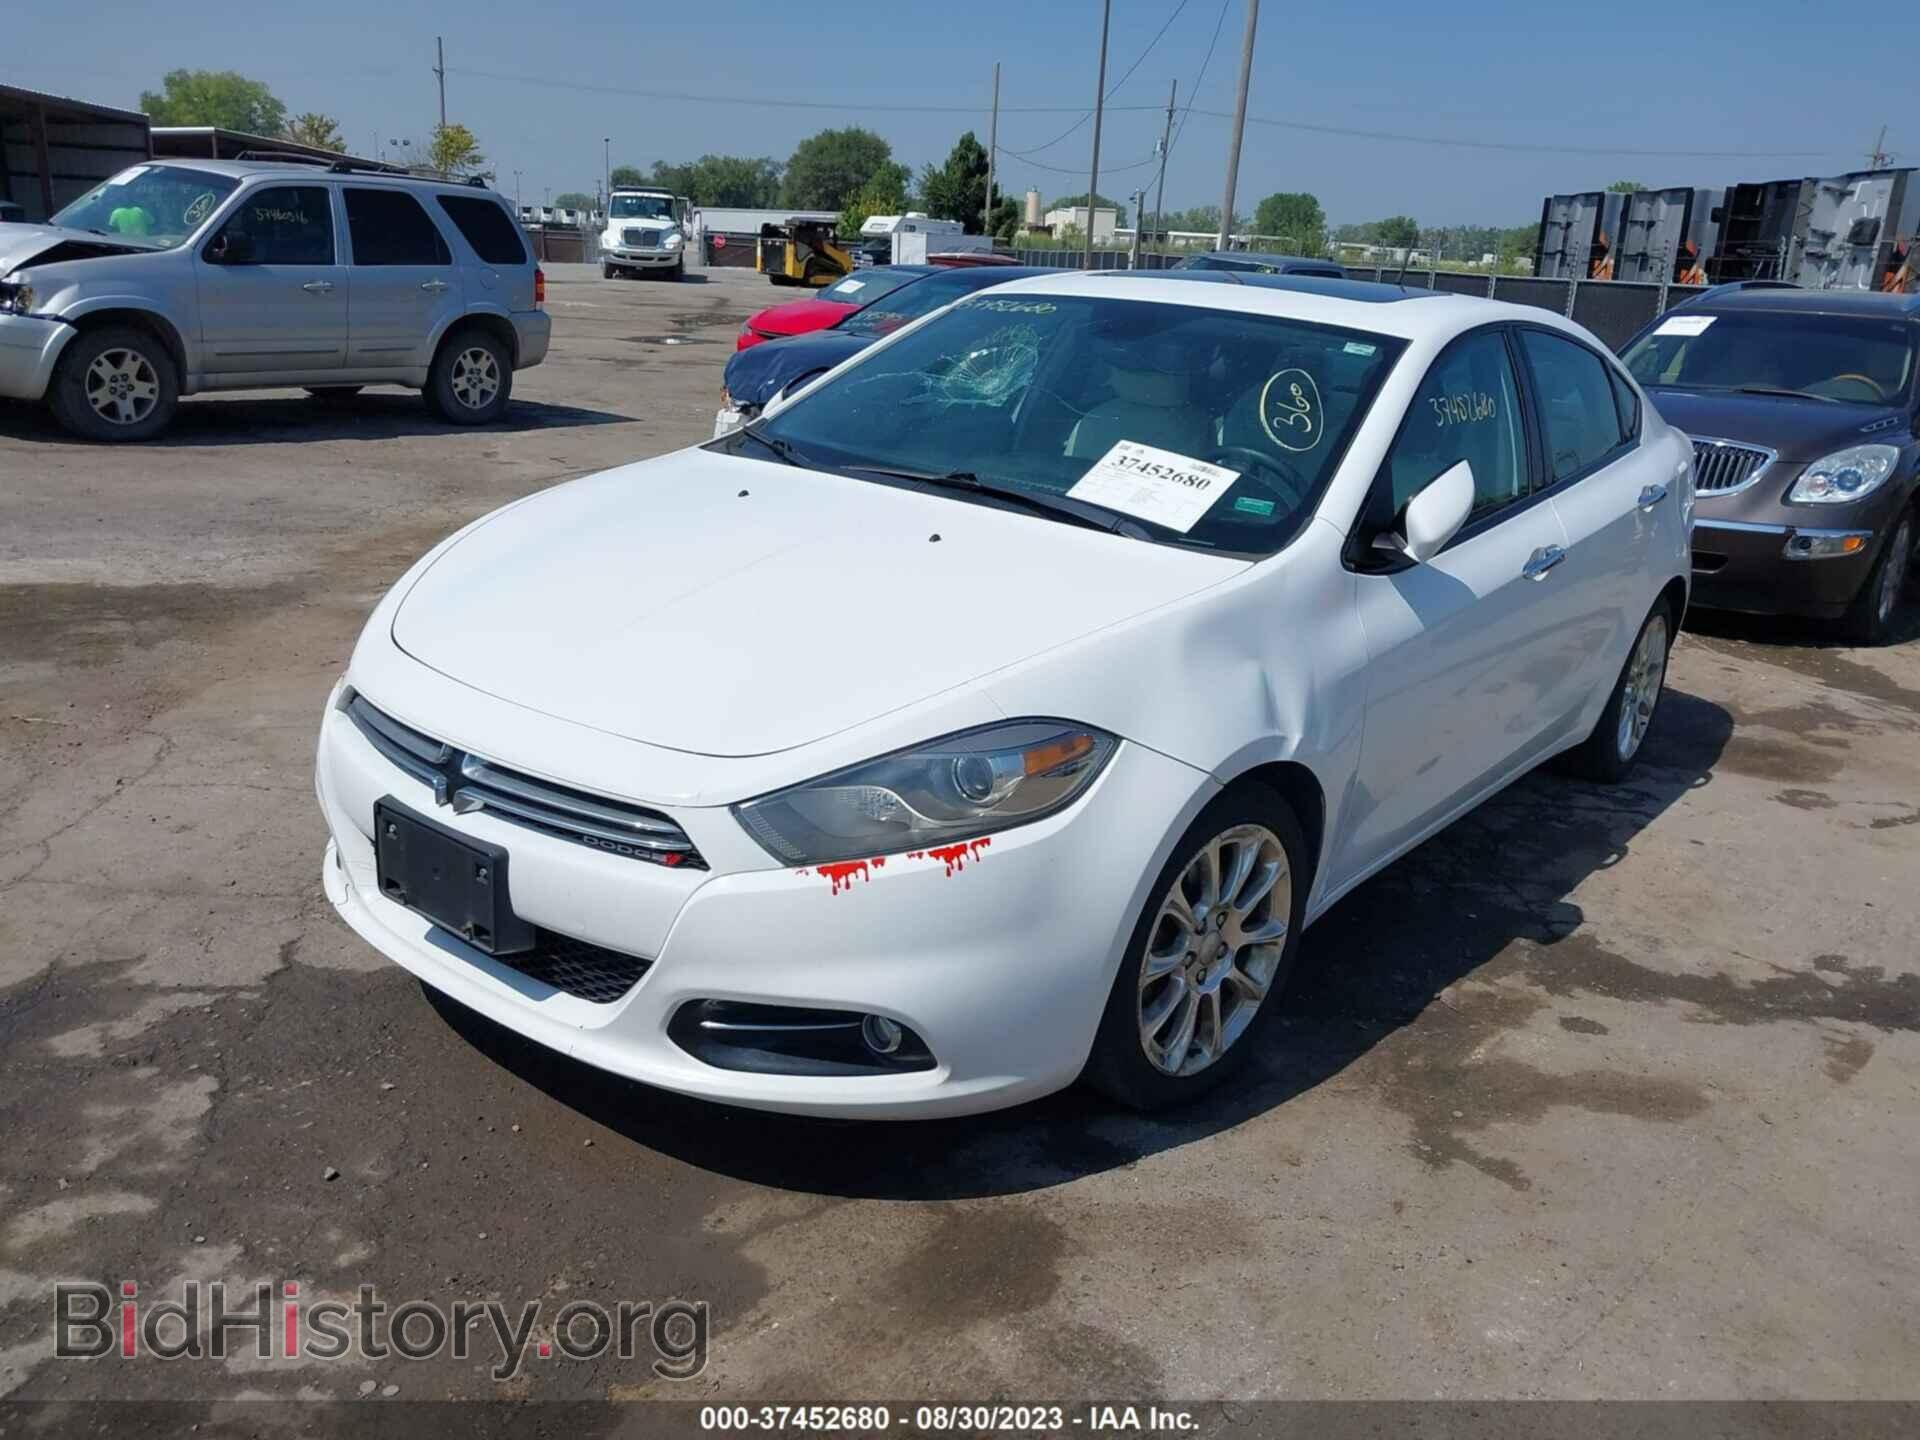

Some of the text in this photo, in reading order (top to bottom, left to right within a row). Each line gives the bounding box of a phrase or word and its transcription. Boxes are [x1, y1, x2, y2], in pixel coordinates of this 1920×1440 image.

[1273, 382, 1312, 433] 360
[1112, 455, 1212, 491] 37452680
[583, 835, 666, 862] DODGE
